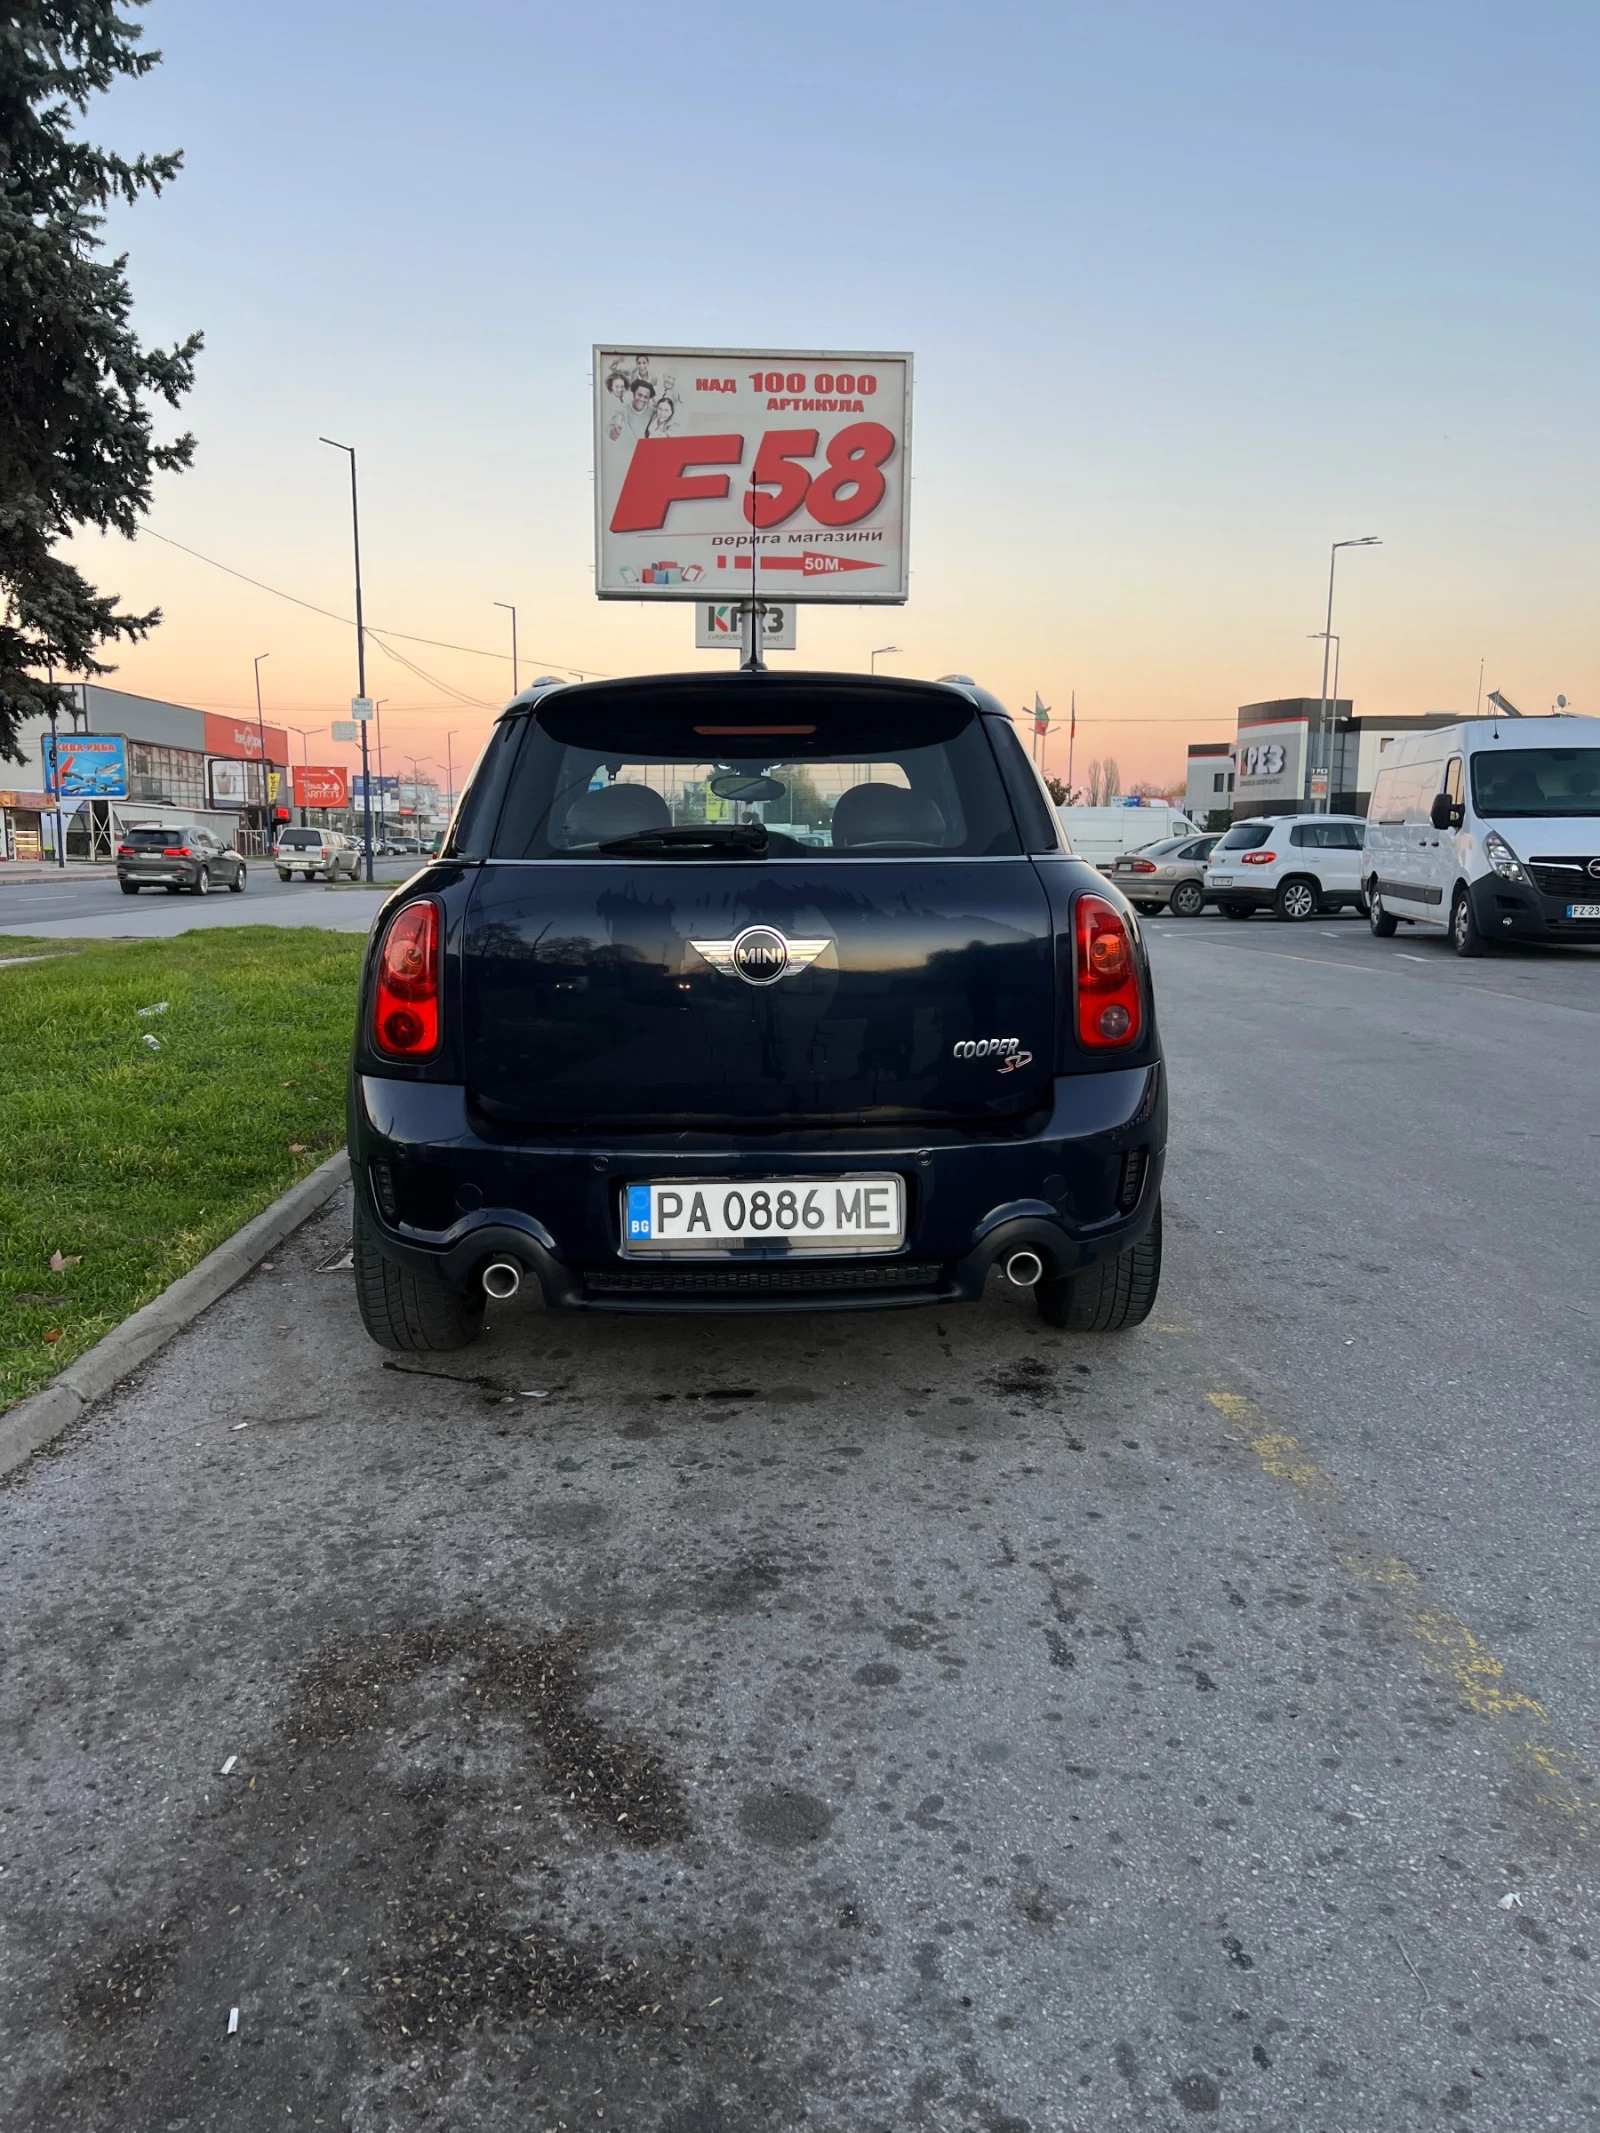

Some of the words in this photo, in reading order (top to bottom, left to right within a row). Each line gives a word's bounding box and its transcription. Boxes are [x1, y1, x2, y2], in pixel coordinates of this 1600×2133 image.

[695, 378, 738, 393] НАД
[748, 372, 806, 394] 100
[814, 373, 878, 395] 000
[766, 398, 865, 413] АРТИКУЛА
[609, 421, 897, 534] F58
[711, 534, 781, 548] верига
[787, 530, 883, 544] магазини
[739, 947, 783, 964] MINI
[953, 1037, 1020, 1059] COOPER
[996, 1050, 1033, 1074] SD
[656, 1191, 712, 1233] PA
[723, 1189, 825, 1232] 0886
[835, 1187, 890, 1229] ME
[631, 1219, 650, 1234] BG
